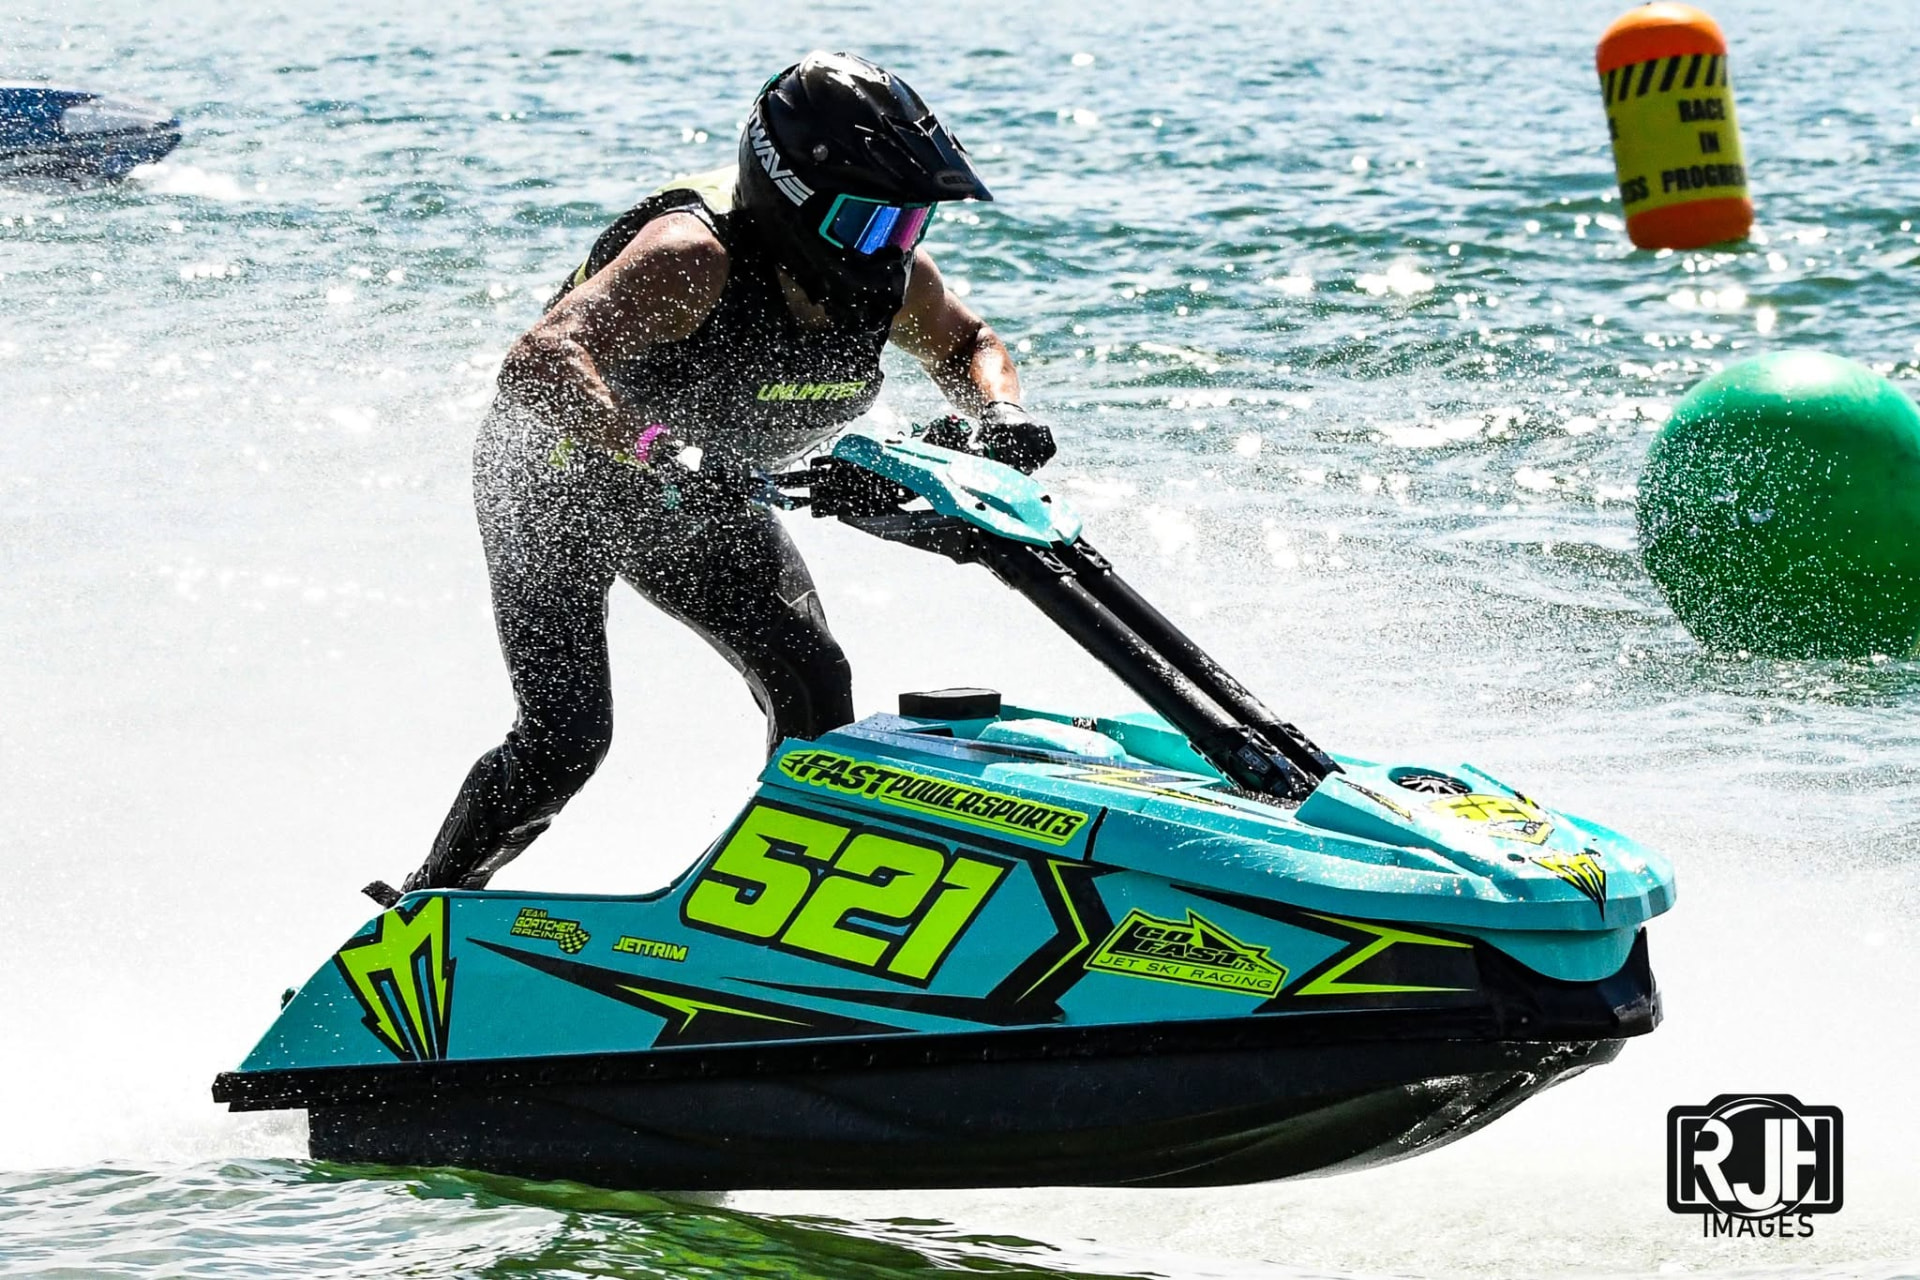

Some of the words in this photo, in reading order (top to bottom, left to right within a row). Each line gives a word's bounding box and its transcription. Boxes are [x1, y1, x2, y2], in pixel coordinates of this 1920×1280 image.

[1678, 98, 1725, 122] RACE
[684, 803, 1006, 982] 521
[521, 908, 547, 918] TEAM
[511, 927, 564, 940] RACING
[1133, 925, 1194, 943] GO
[613, 936, 688, 961] JETTRIM
[1100, 956, 1140, 968] JET
[1146, 962, 1180, 975] SKI
[1190, 969, 1273, 989] RACING
